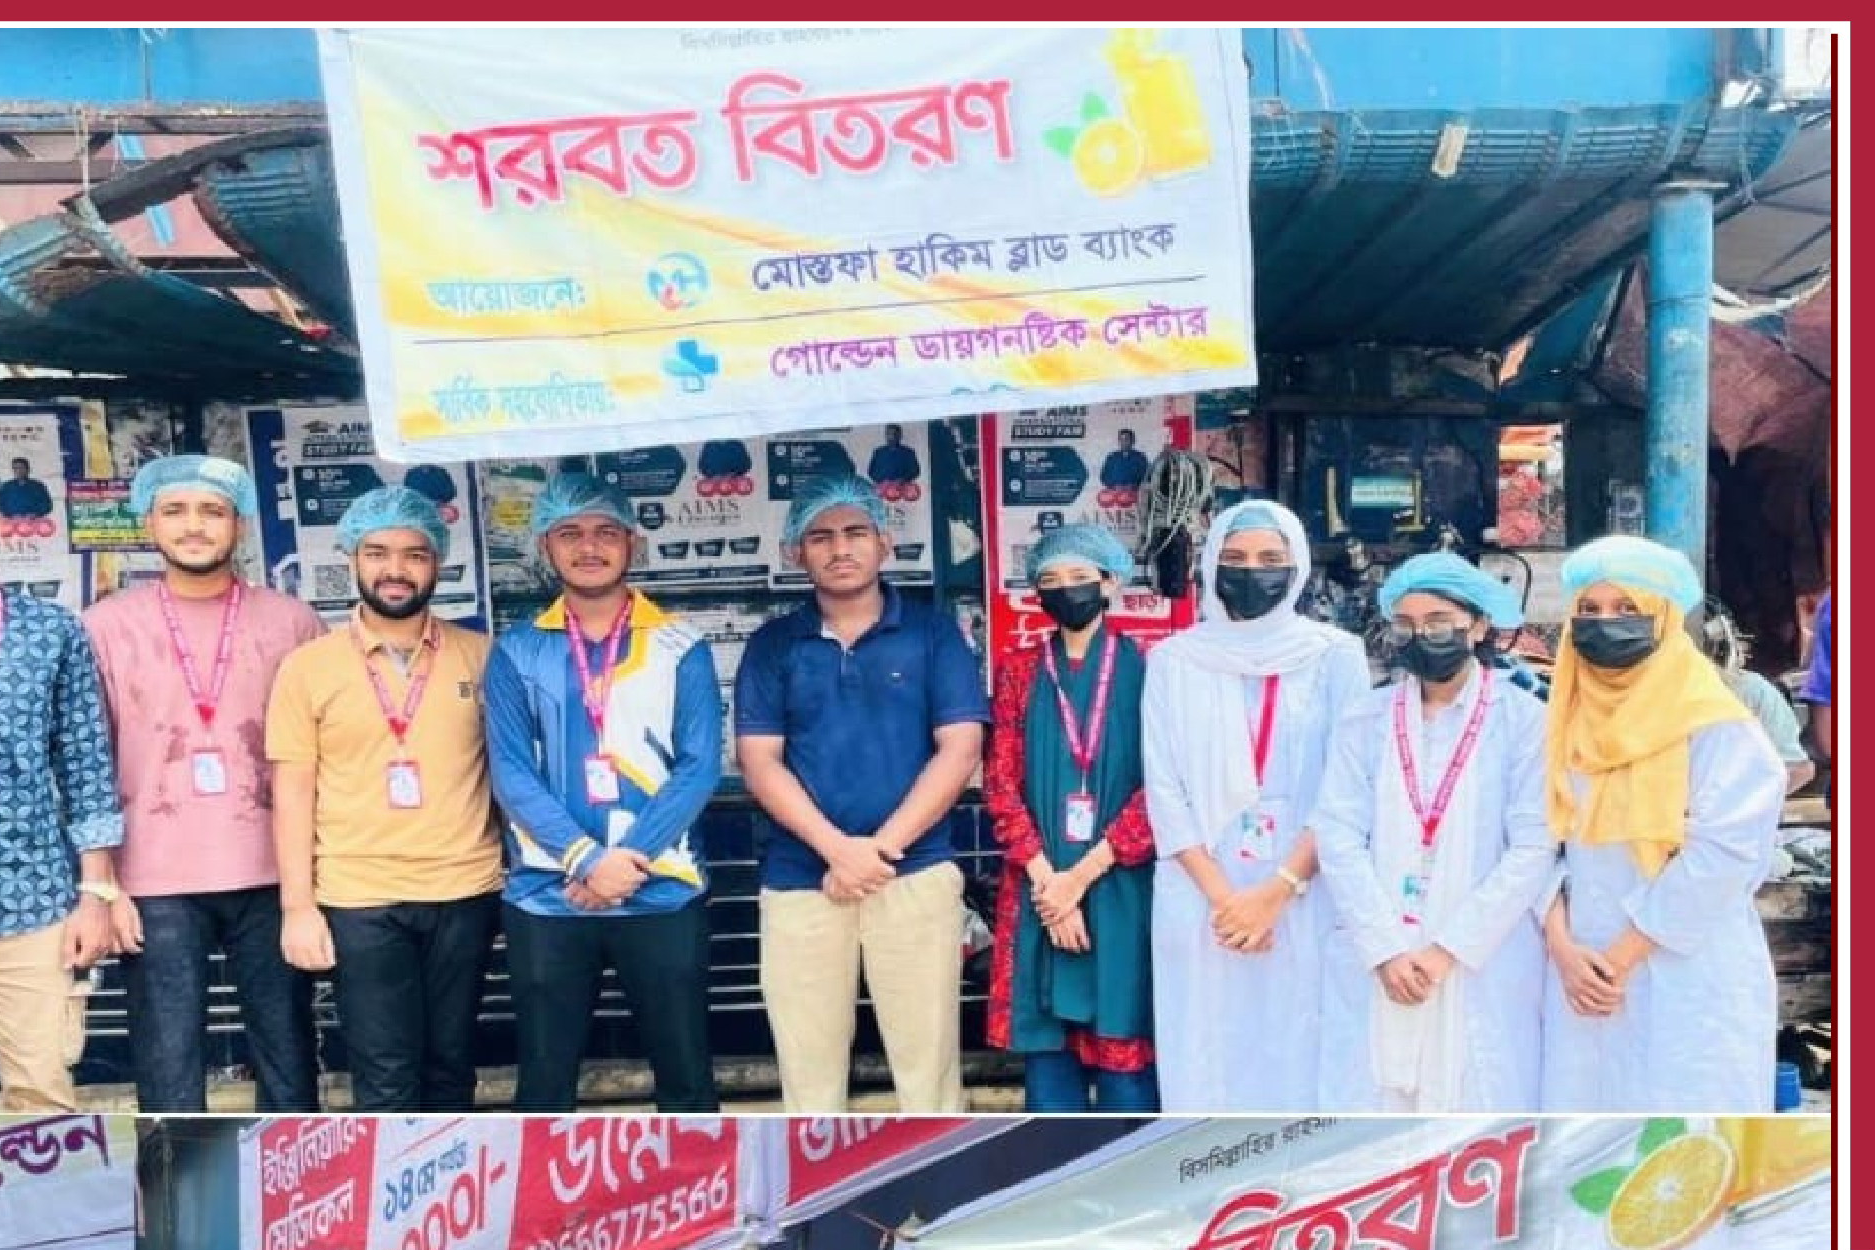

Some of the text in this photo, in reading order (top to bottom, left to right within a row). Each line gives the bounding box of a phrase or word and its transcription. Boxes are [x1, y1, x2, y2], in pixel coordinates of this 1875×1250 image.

[415, 69, 1012, 210] শরবত বিতরণ
[751, 221, 1177, 292] মোস্তফা হাকিম ব্লাড ব্যাংক
[770, 334, 897, 379] গোল্ডেন
[1101, 300, 1211, 348] সেন্টার
[336, 422, 373, 434] AIM
[1178, 1130, 1278, 1184] বিসমিল্লাহির
[382, 1166, 415, 1222] ১৪
